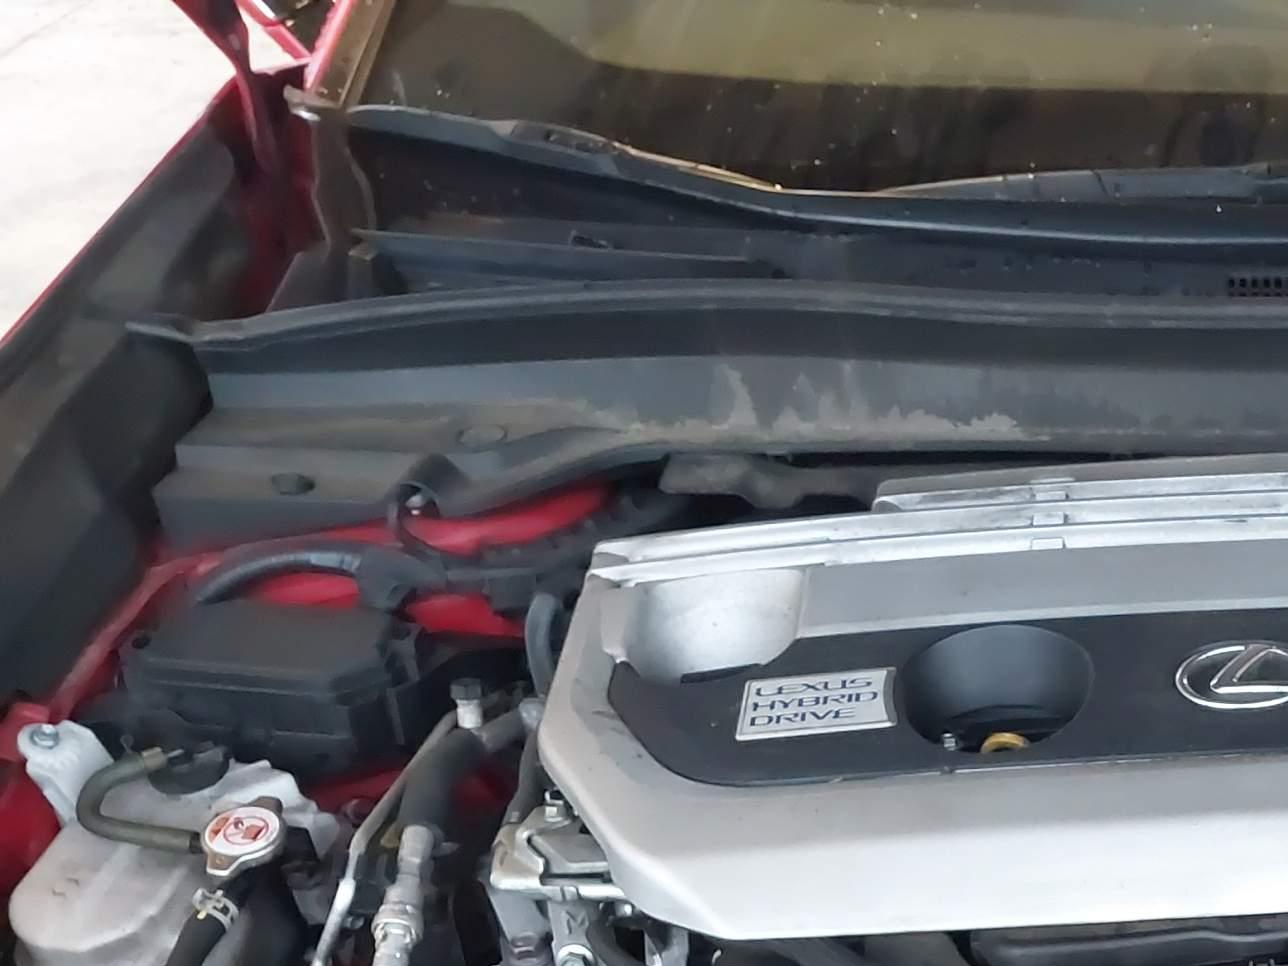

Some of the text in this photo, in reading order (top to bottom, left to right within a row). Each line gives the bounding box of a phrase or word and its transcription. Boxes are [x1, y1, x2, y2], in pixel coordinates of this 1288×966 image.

[755, 677, 872, 697] LEXUS
[752, 691, 878, 712] HYBRID
[749, 706, 856, 726] DRIVE
